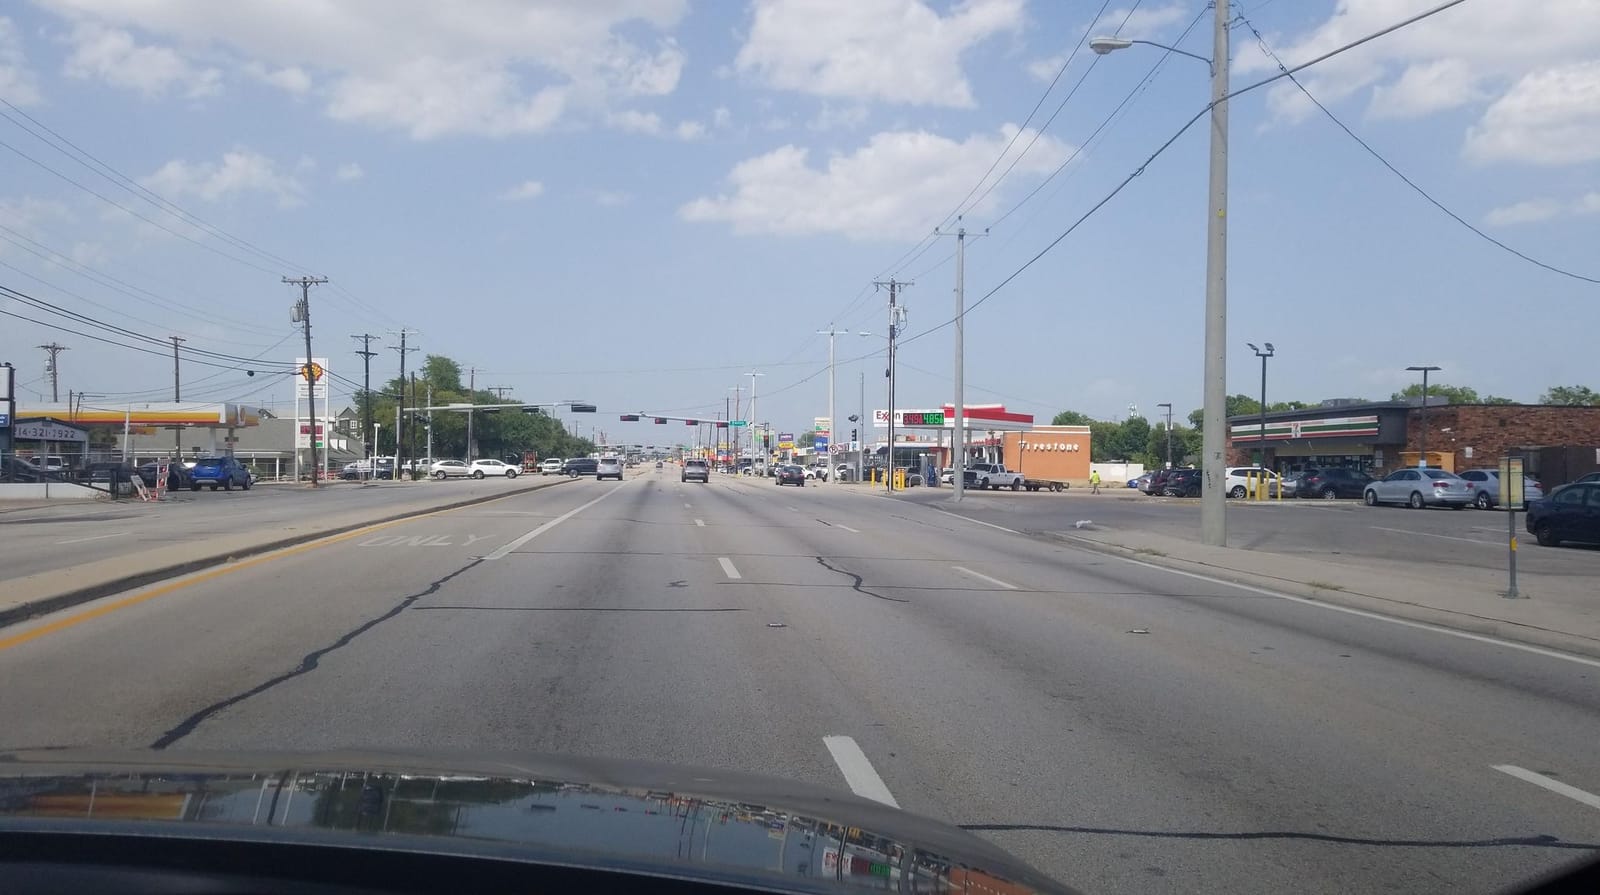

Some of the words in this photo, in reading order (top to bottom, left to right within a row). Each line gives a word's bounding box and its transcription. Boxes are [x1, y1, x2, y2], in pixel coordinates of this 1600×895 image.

[876, 411, 901, 422] Exxn
[1018, 440, 1080, 452] Firestone
[357, 534, 497, 547] ONLY
